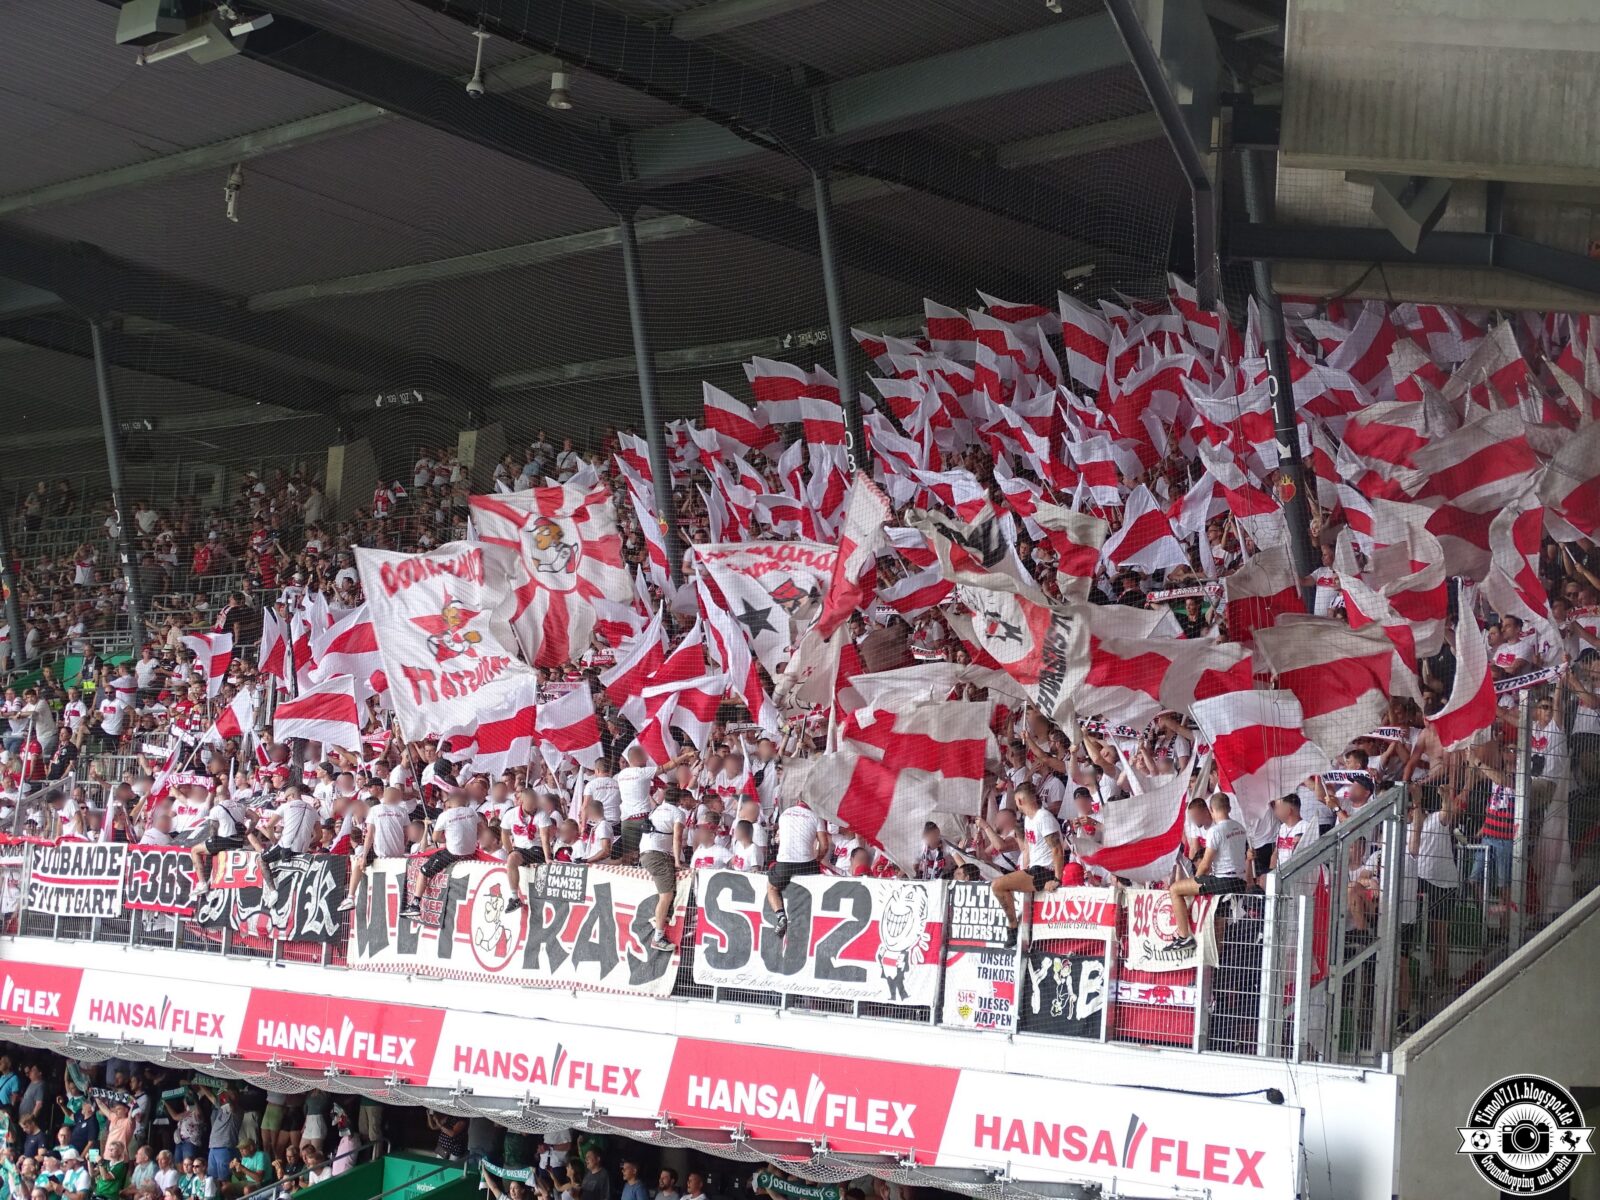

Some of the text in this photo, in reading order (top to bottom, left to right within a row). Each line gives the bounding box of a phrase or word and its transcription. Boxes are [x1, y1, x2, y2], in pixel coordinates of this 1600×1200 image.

[1264, 348, 1279, 424] 101
[842, 408, 857, 473] 103
[547, 876, 583, 891] IMMER
[549, 865, 585, 878] DU BIST
[28, 882, 118, 915] STUTTGART
[561, 889, 582, 900] UNS!
[951, 923, 1009, 942] WIDERSTA
[977, 966, 1015, 983] TRIKOTS
[980, 952, 1015, 968] UNSERE
[12, 987, 61, 1018] FLEX
[978, 996, 1010, 1012] DIESES
[89, 998, 226, 1039] HANSA FLEX
[973, 1010, 1012, 1027] WAPPEN
[256, 1018, 417, 1067] HANSA FLEX
[453, 1045, 642, 1098] HANSA FLEX
[687, 1074, 917, 1140] HANSA FLEX
[974, 1113, 1267, 1188] HANSA FLEX
